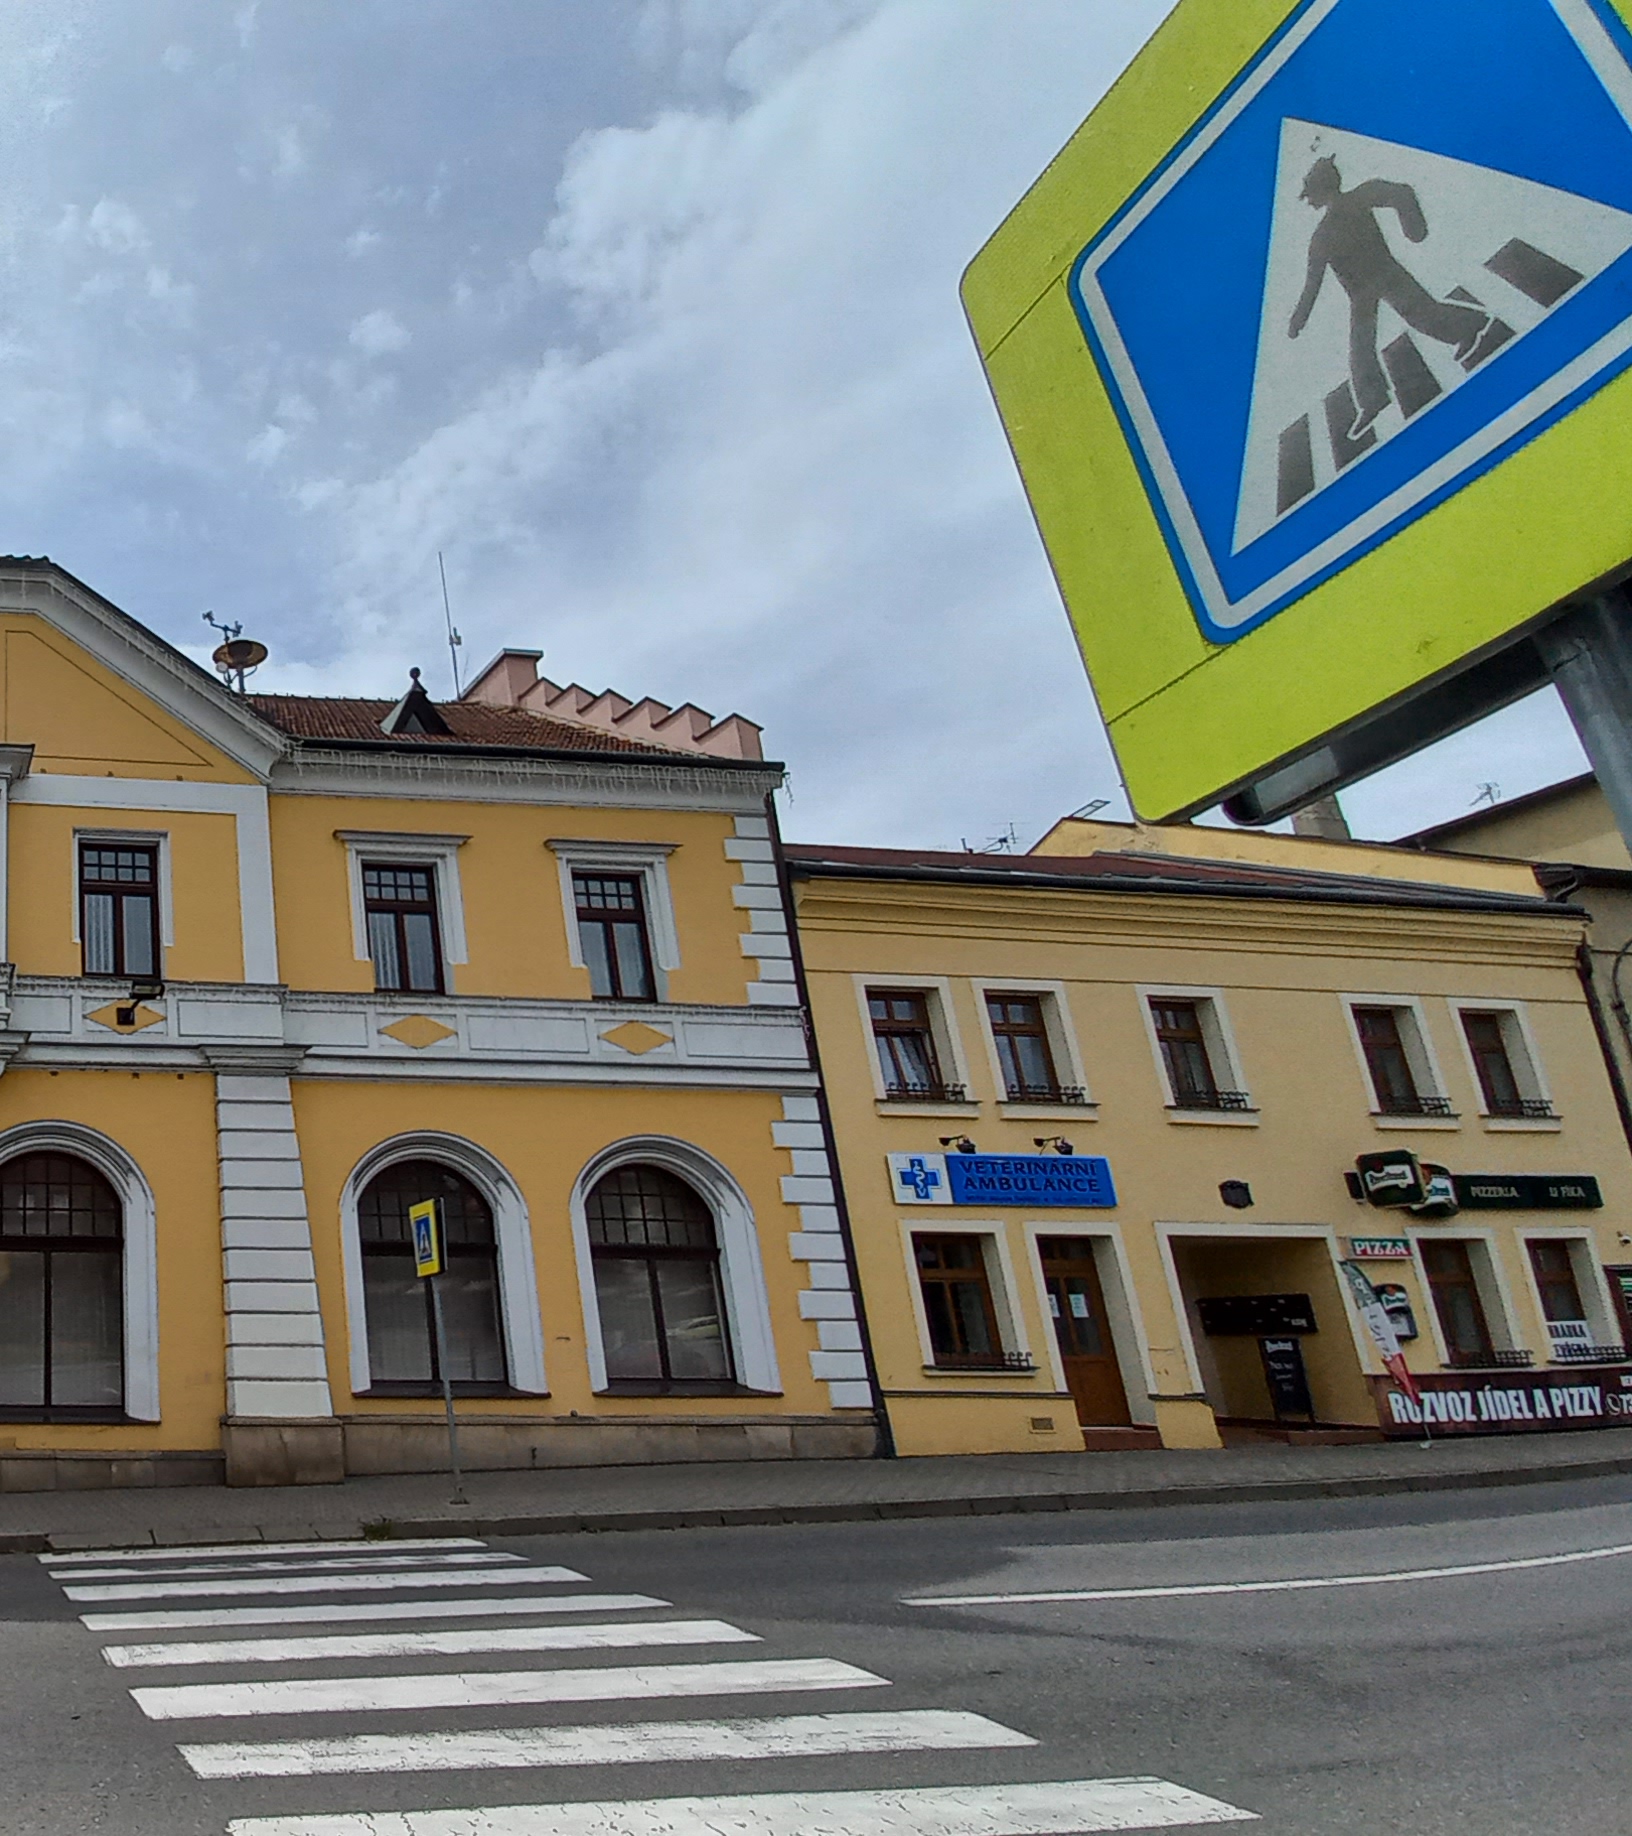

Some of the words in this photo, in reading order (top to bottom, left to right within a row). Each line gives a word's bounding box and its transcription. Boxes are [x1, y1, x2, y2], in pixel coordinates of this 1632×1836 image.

[959, 1159, 1097, 1176] VETERINÁRNÍ
[964, 1177, 1101, 1192] AMBULANCE
[1354, 1240, 1410, 1256] PIZZA
[1476, 1384, 1534, 1422] JÍDEL
[1534, 1389, 1552, 1419] A
[1549, 1385, 1604, 1417] PIZZY
